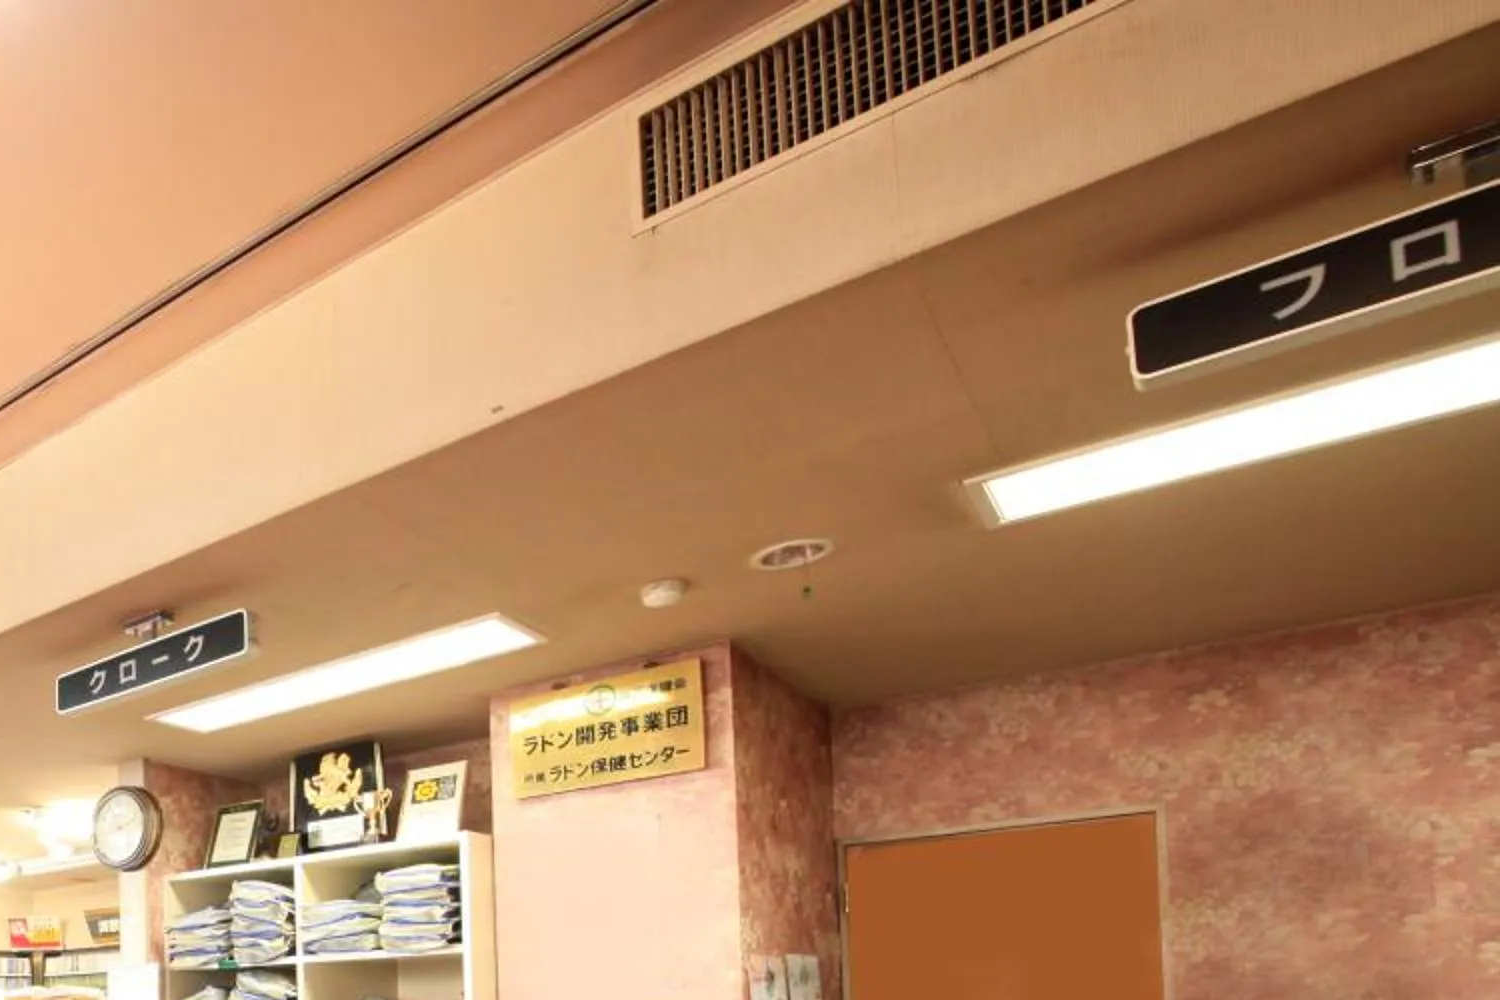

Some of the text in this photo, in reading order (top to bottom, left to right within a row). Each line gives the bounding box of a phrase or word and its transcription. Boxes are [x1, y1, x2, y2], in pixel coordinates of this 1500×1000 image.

[1259, 220, 1461, 320] フロ
[89, 635, 204, 694] クローク
[524, 705, 689, 756] ラドン開発事業団
[549, 746, 691, 783] ラドン保健センター
